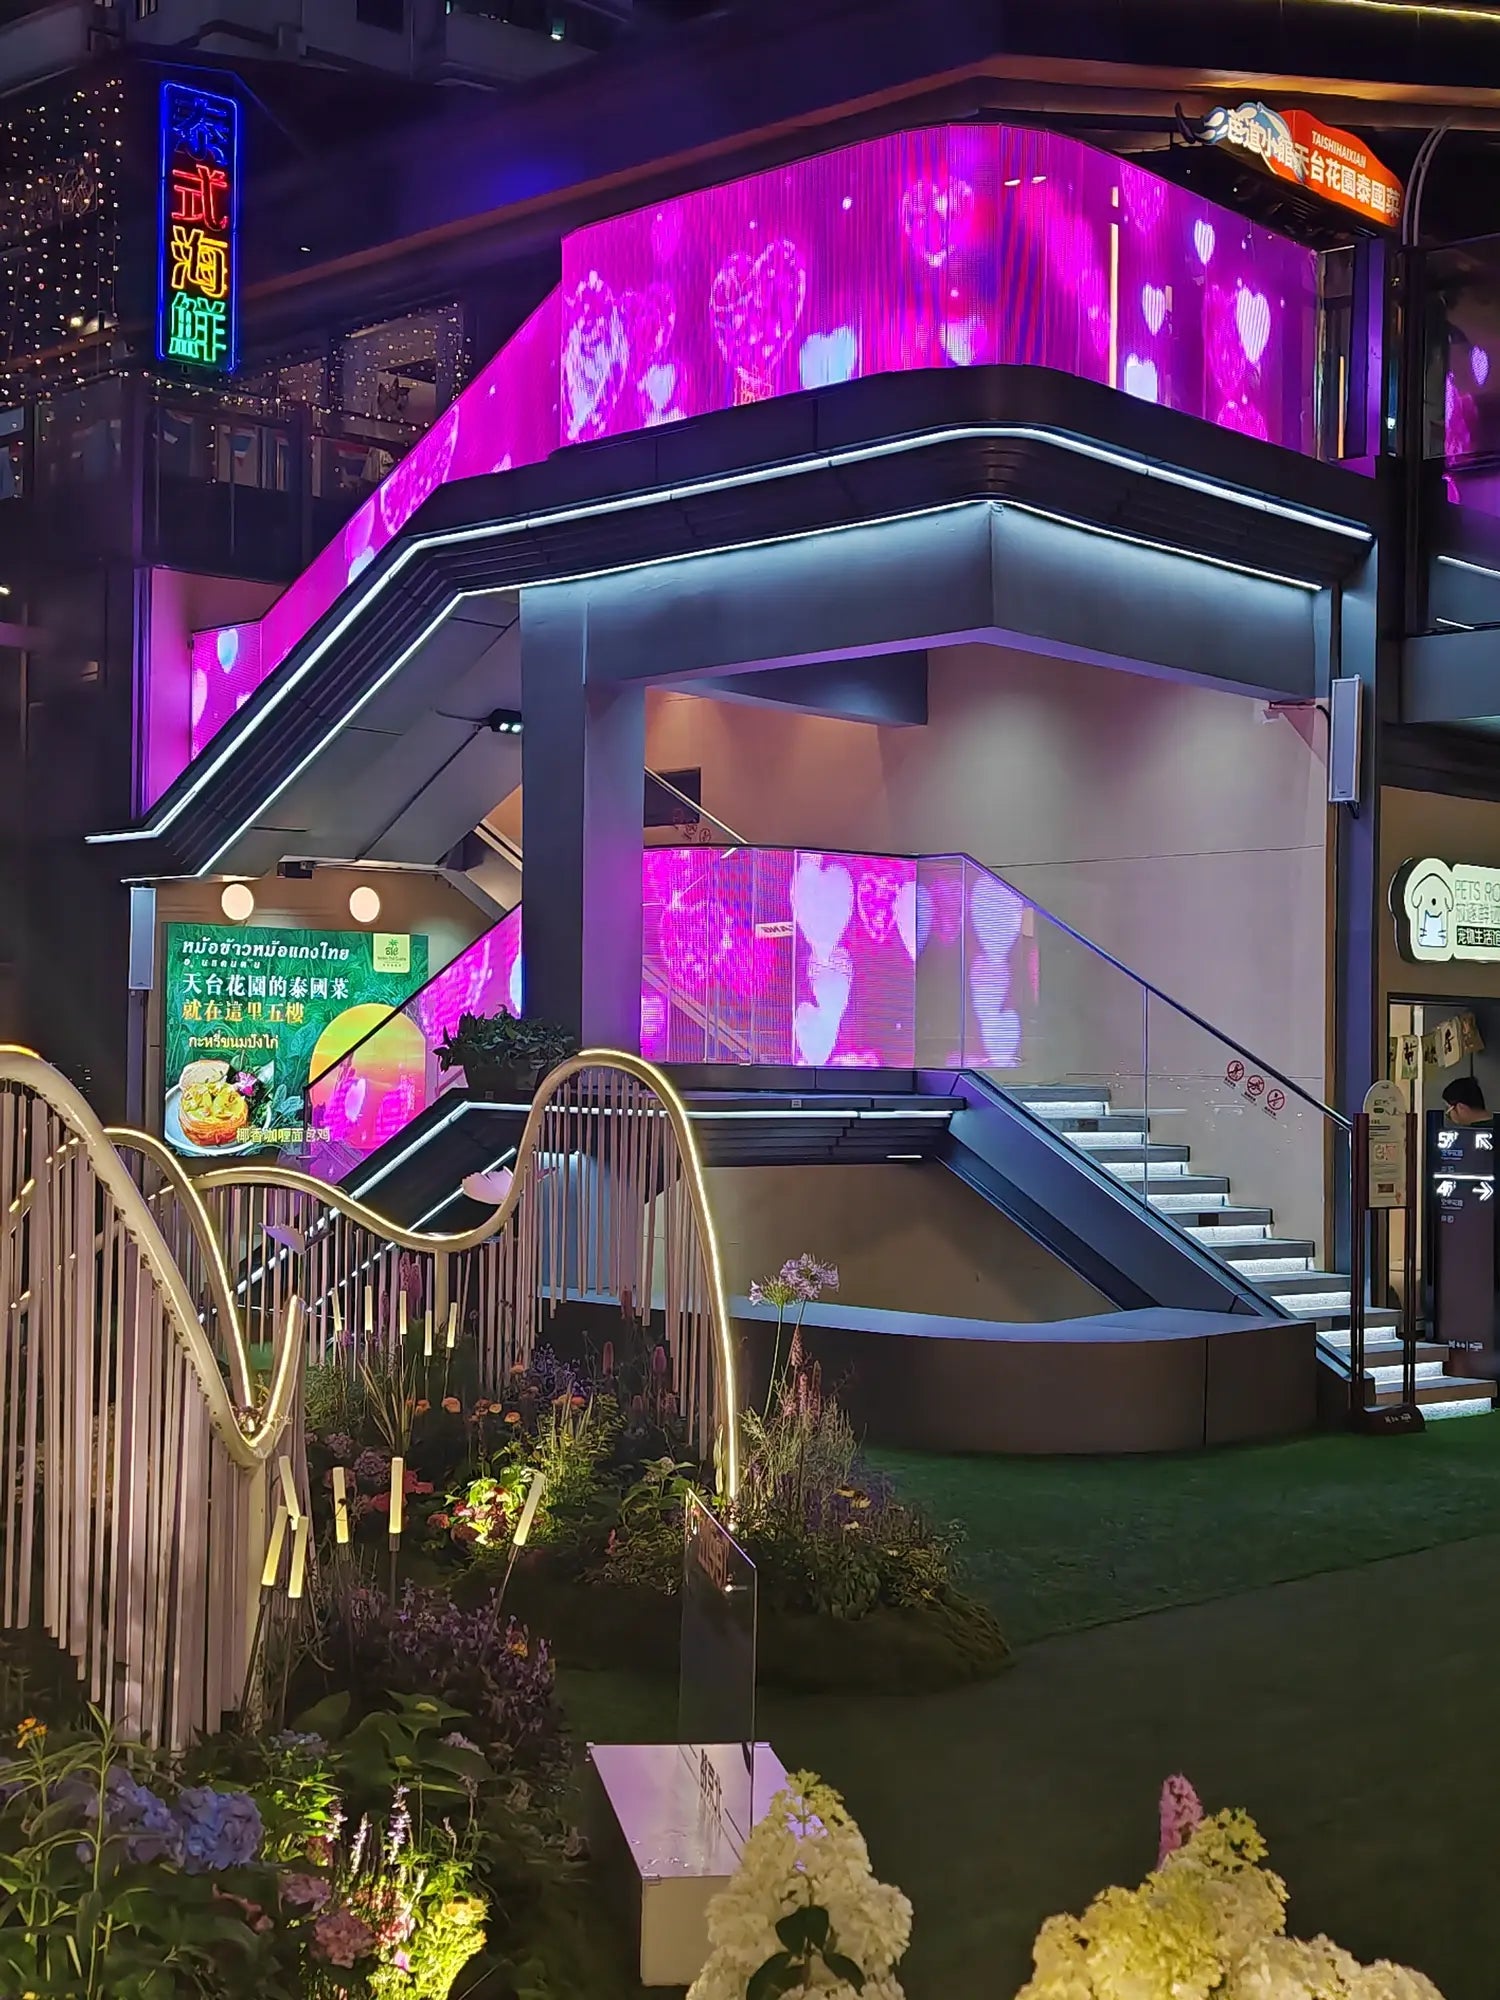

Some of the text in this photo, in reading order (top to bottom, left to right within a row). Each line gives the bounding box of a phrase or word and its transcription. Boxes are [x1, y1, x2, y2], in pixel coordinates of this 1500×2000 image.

[1311, 130, 1367, 169] TAISHIHAIXIAN
[169, 98, 229, 362] 泰式海鮮
[1455, 880, 1480, 900] PETS
[182, 972, 349, 1000] 天台花園的泰國菜
